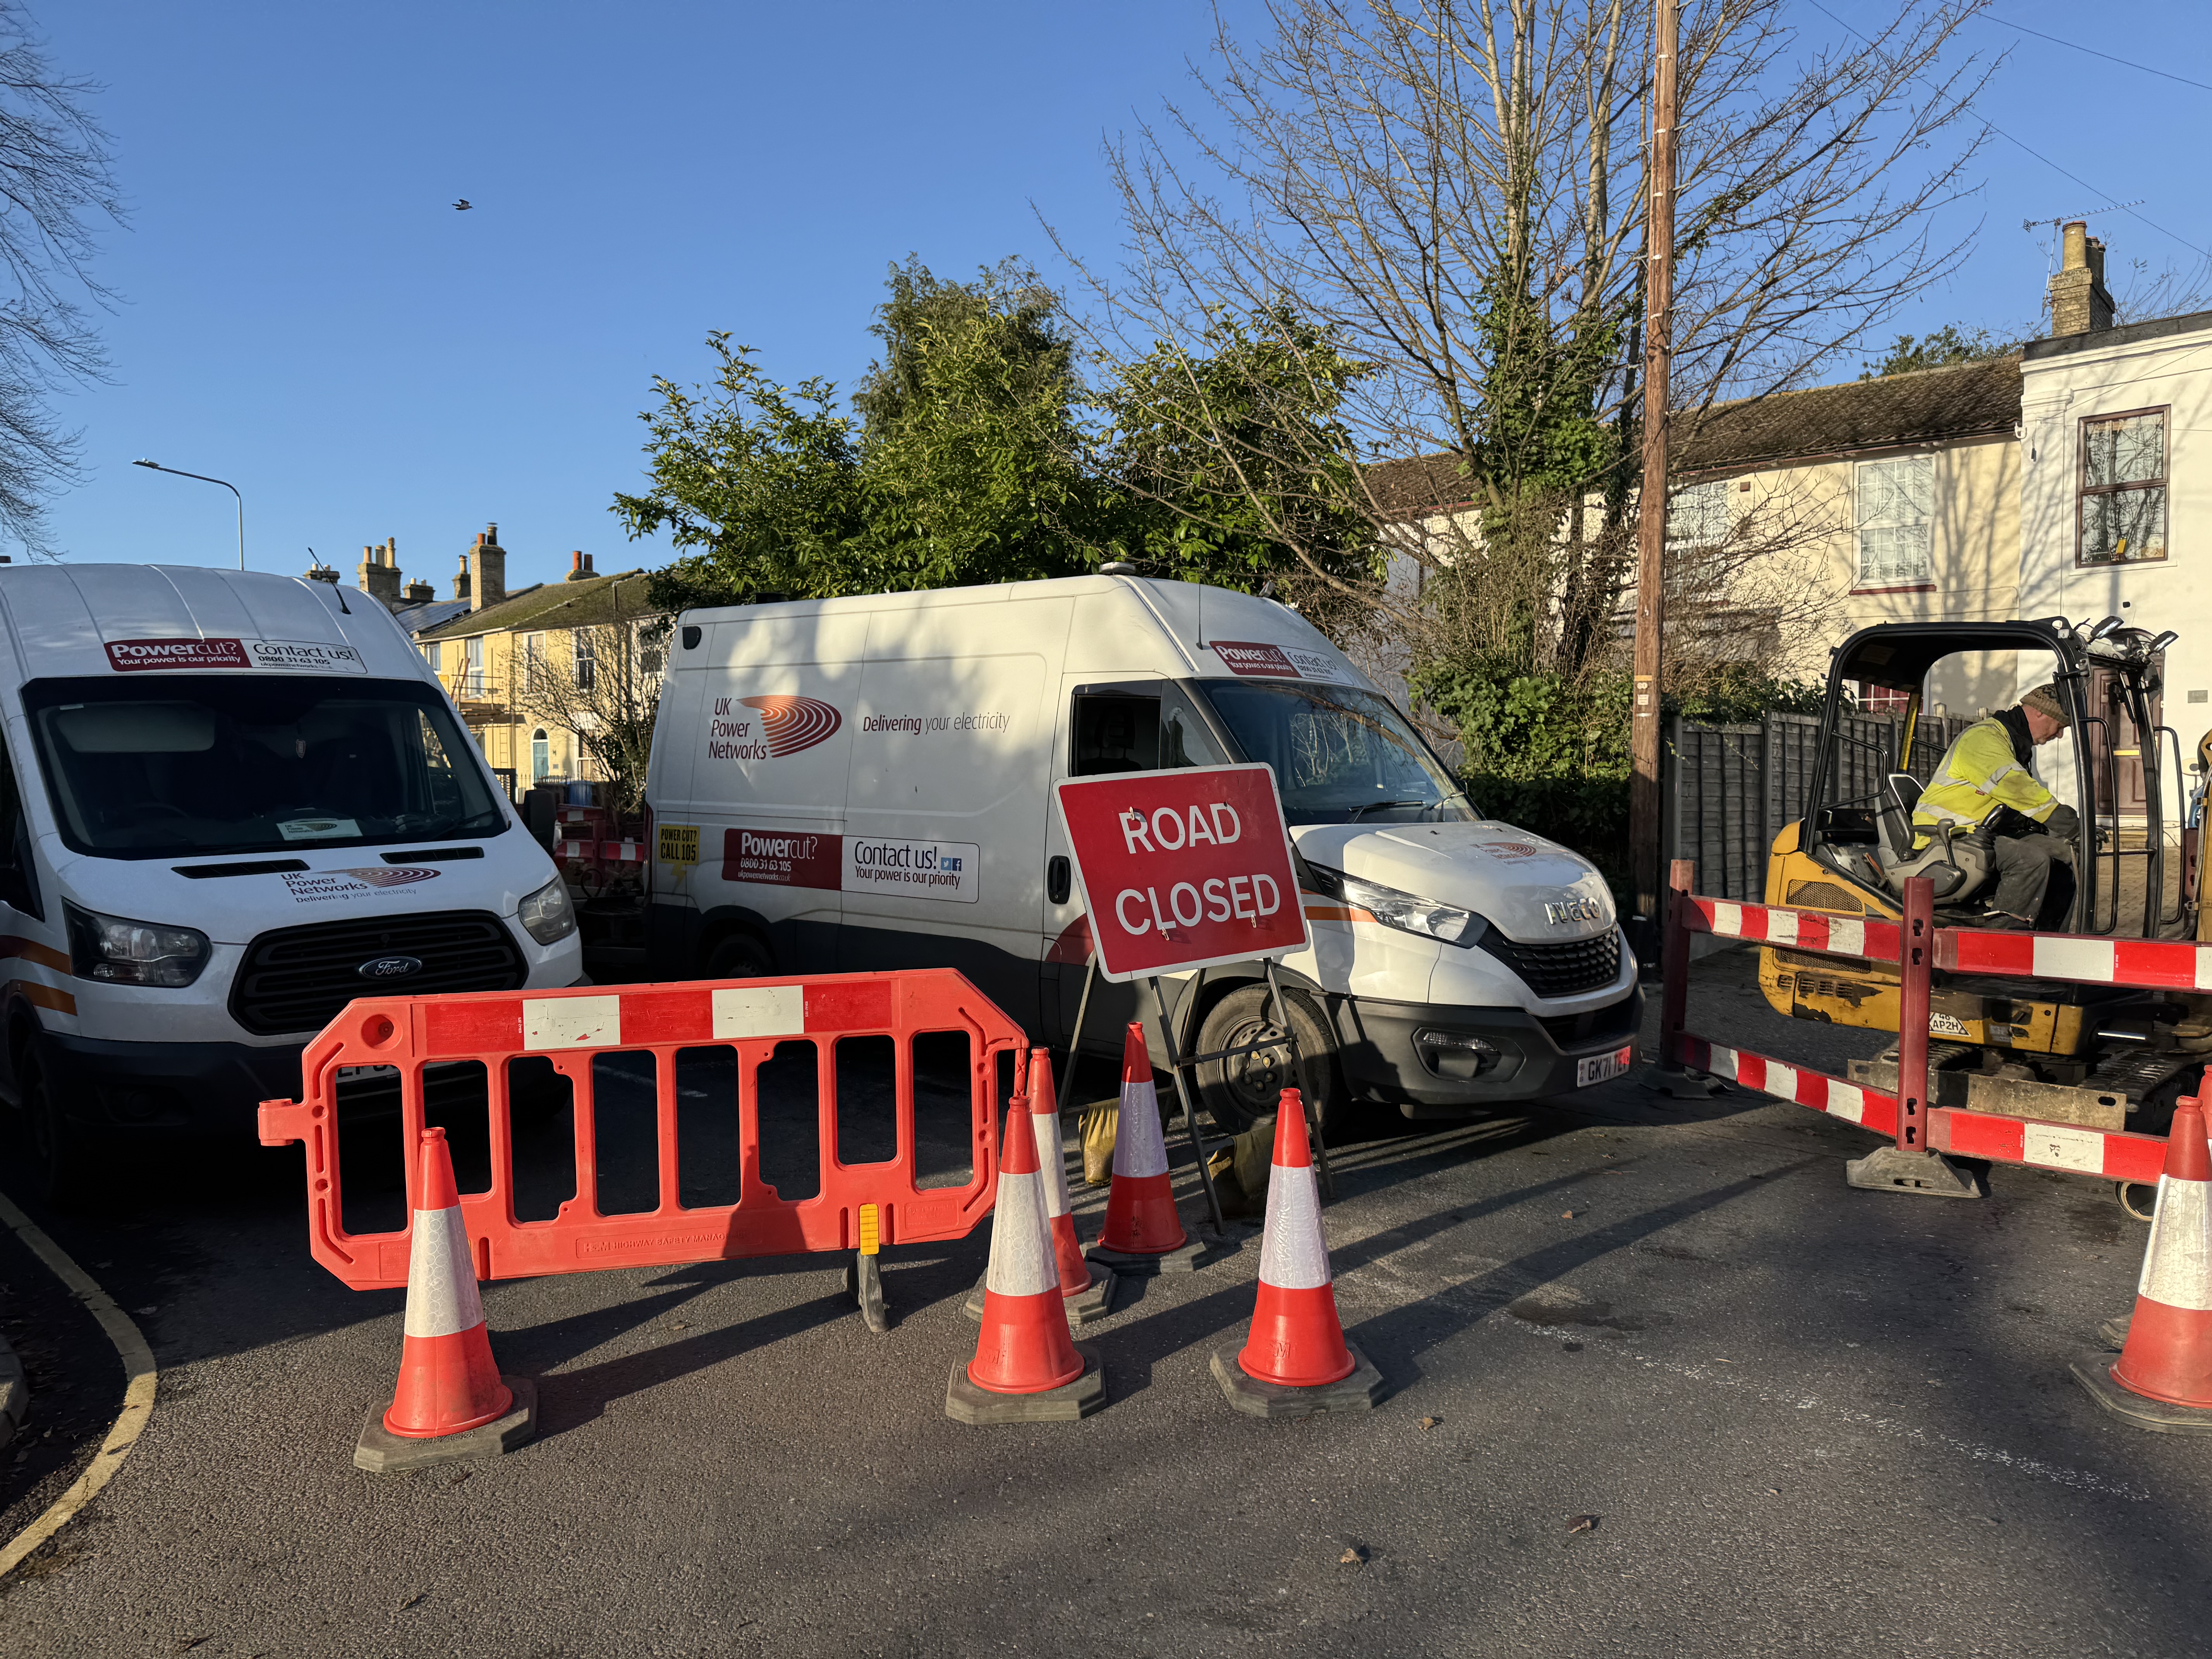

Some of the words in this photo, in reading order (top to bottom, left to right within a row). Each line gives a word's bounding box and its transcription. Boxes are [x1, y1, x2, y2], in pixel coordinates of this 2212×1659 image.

[111, 641, 237, 658] Powercut?
[253, 644, 325, 658] Contact
[327, 650, 355, 661] us!
[1215, 645, 1285, 663] Powercut?
[143, 657, 176, 665] power
[206, 654, 241, 663] priority
[714, 697, 732, 716] UK
[711, 719, 750, 737] Power
[863, 714, 922, 735] Delivering
[925, 717, 951, 735] your
[953, 711, 1010, 733] electricity
[708, 738, 767, 760] Networks
[661, 828, 681, 841] POWER
[682, 830, 697, 842] CUT?
[1118, 802, 1241, 854] ROAD
[661, 842, 680, 860] CALL
[682, 843, 696, 861] 105
[741, 832, 818, 859] Powercut?
[855, 841, 911, 867] Contact
[915, 846, 937, 869] us!
[740, 857, 759, 869] 0800
[759, 859, 768, 870] 31
[769, 860, 778, 871] 63
[779, 860, 792, 872] 105
[285, 877, 336, 888] Power
[855, 866, 874, 879] Your
[875, 869, 902, 883] power
[904, 868, 910, 882] is
[912, 872, 927, 884] our
[929, 871, 960, 890] priority
[290, 882, 368, 896] Networks
[295, 893, 349, 903] Delivering
[351, 891, 372, 899] your
[1115, 873, 1280, 936] CLOSED
[1544, 896, 1602, 925] IVECO
[375, 960, 409, 976] Ford
[1933, 1020, 1959, 1031] AP2H
[1588, 1056, 1611, 1081] GK71
